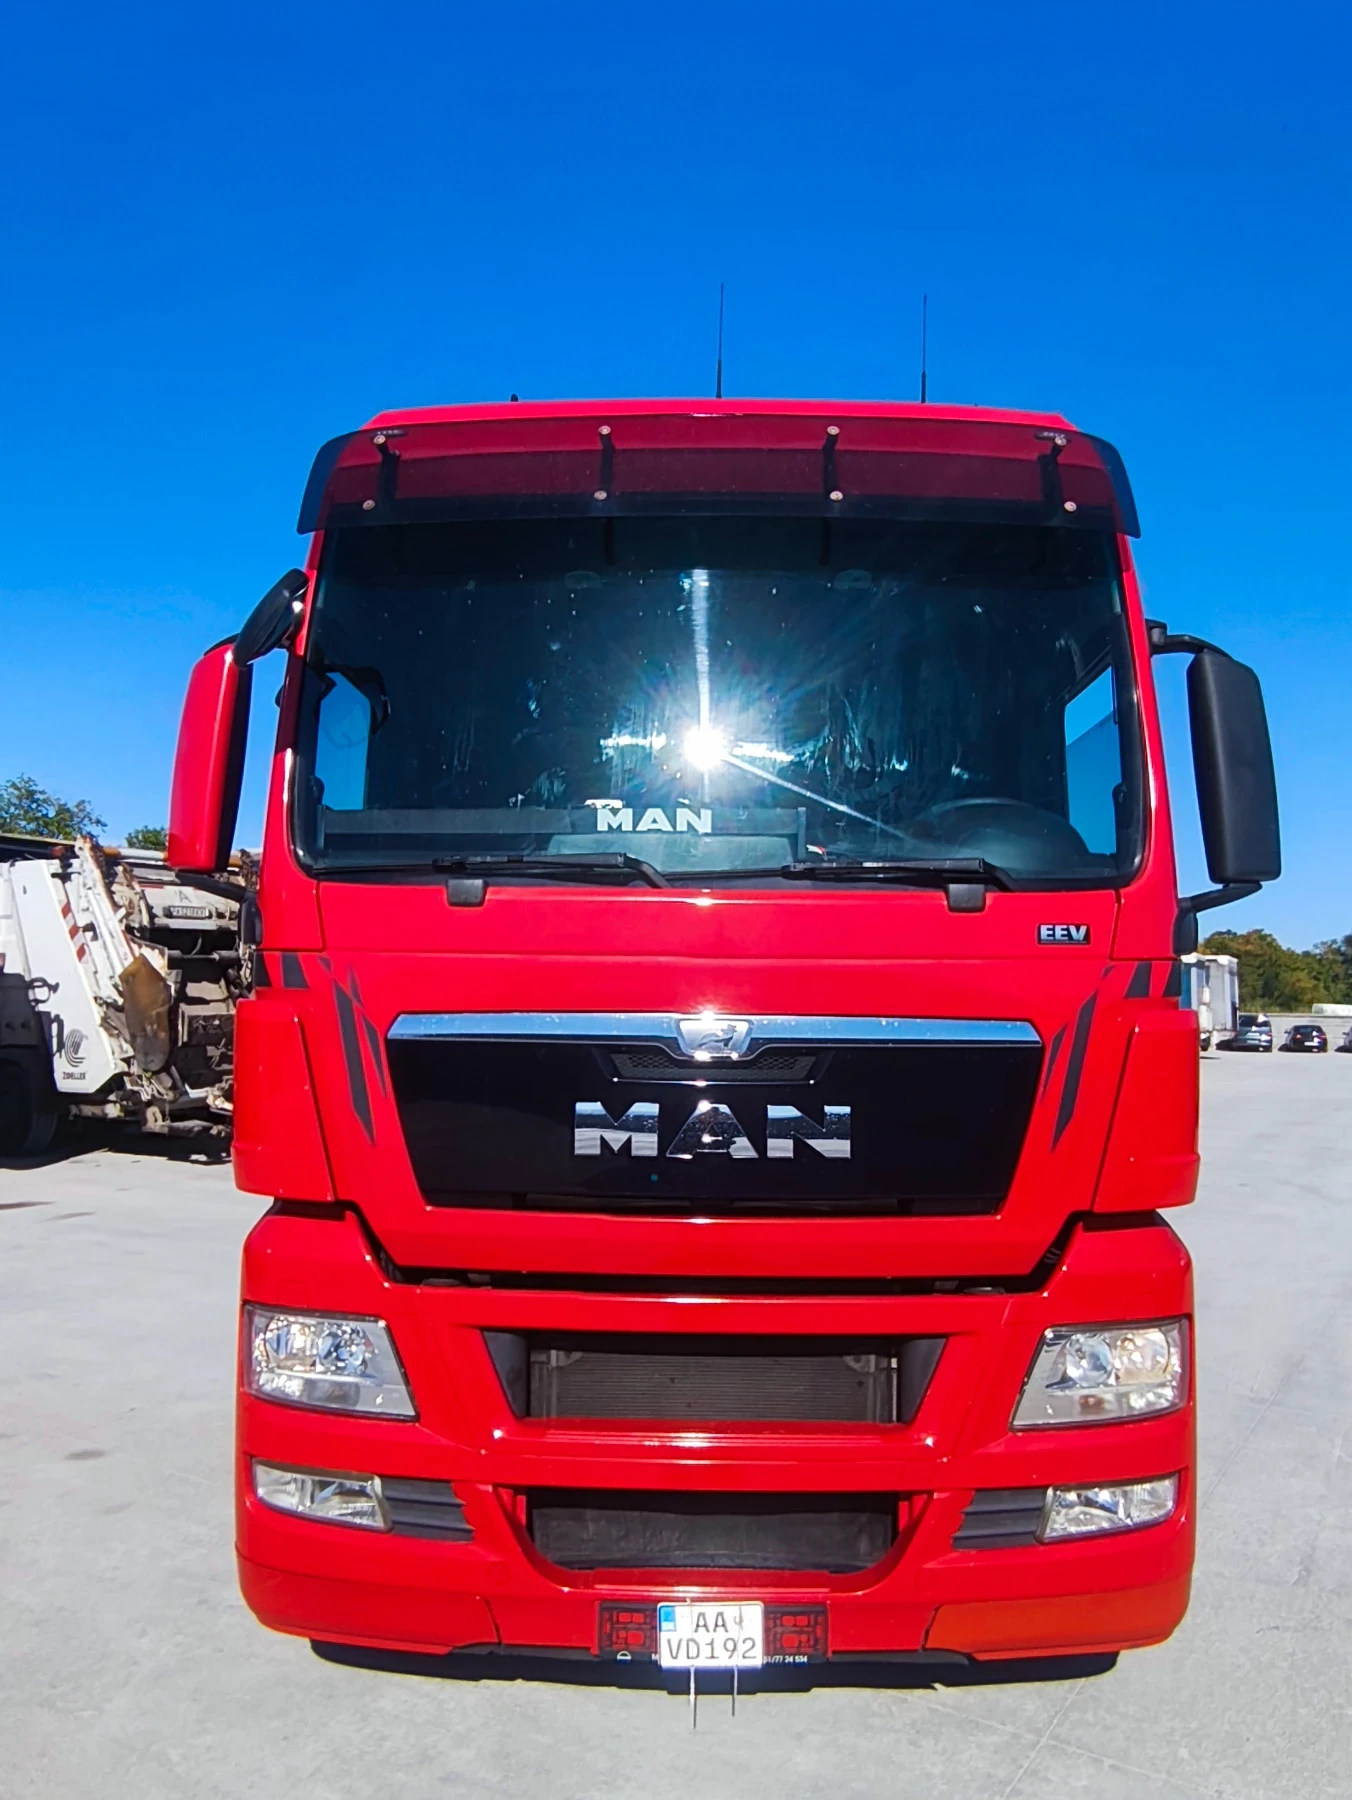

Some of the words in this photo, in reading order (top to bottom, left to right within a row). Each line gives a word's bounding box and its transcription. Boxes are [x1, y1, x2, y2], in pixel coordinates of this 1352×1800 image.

[597, 807, 712, 834] MAN
[1040, 924, 1088, 941] EEV
[574, 1101, 851, 1159] MAN
[694, 1611, 729, 1633] AA
[667, 1637, 757, 1660] VD192
